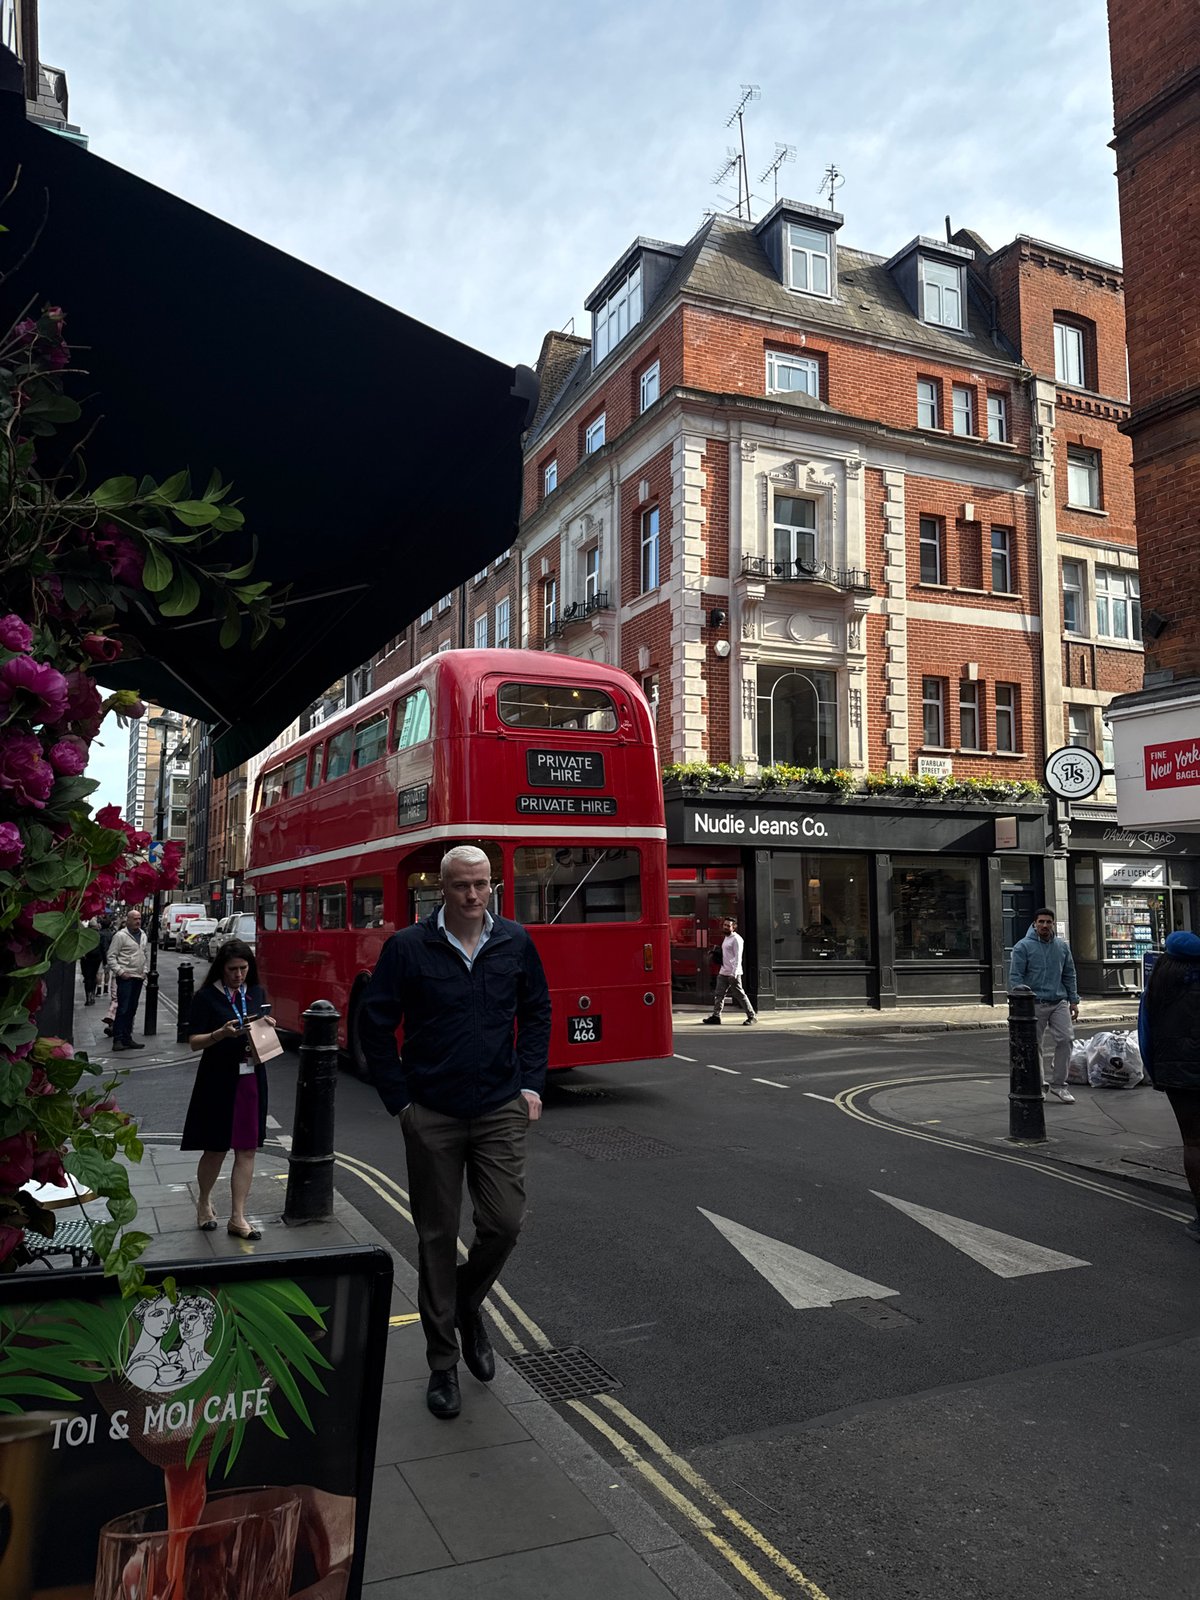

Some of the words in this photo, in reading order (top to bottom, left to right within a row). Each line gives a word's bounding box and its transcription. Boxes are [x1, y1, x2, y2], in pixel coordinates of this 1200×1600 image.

[537, 754, 593, 769] PRIVATE
[1150, 750, 1167, 760] FINE
[921, 759, 946, 767] D'ARBLAY
[550, 769, 582, 782] HIRE
[1150, 761, 1172, 781] New
[403, 789, 425, 807] PRIVATE
[521, 797, 575, 812] PRIVATE
[581, 800, 612, 813] HIRE
[694, 812, 745, 834] Nudie
[749, 815, 799, 836] Jeans
[802, 817, 829, 837] Co.
[1113, 869, 1126, 877] OFF
[1127, 869, 1155, 878] LICENCE
[572, 1017, 594, 1030] TAS
[573, 1029, 596, 1042] 466
[50, 1413, 98, 1450] TOI
[108, 1410, 129, 1440] &
[142, 1399, 196, 1435] MOI
[203, 1377, 271, 1424] CAFÉ
